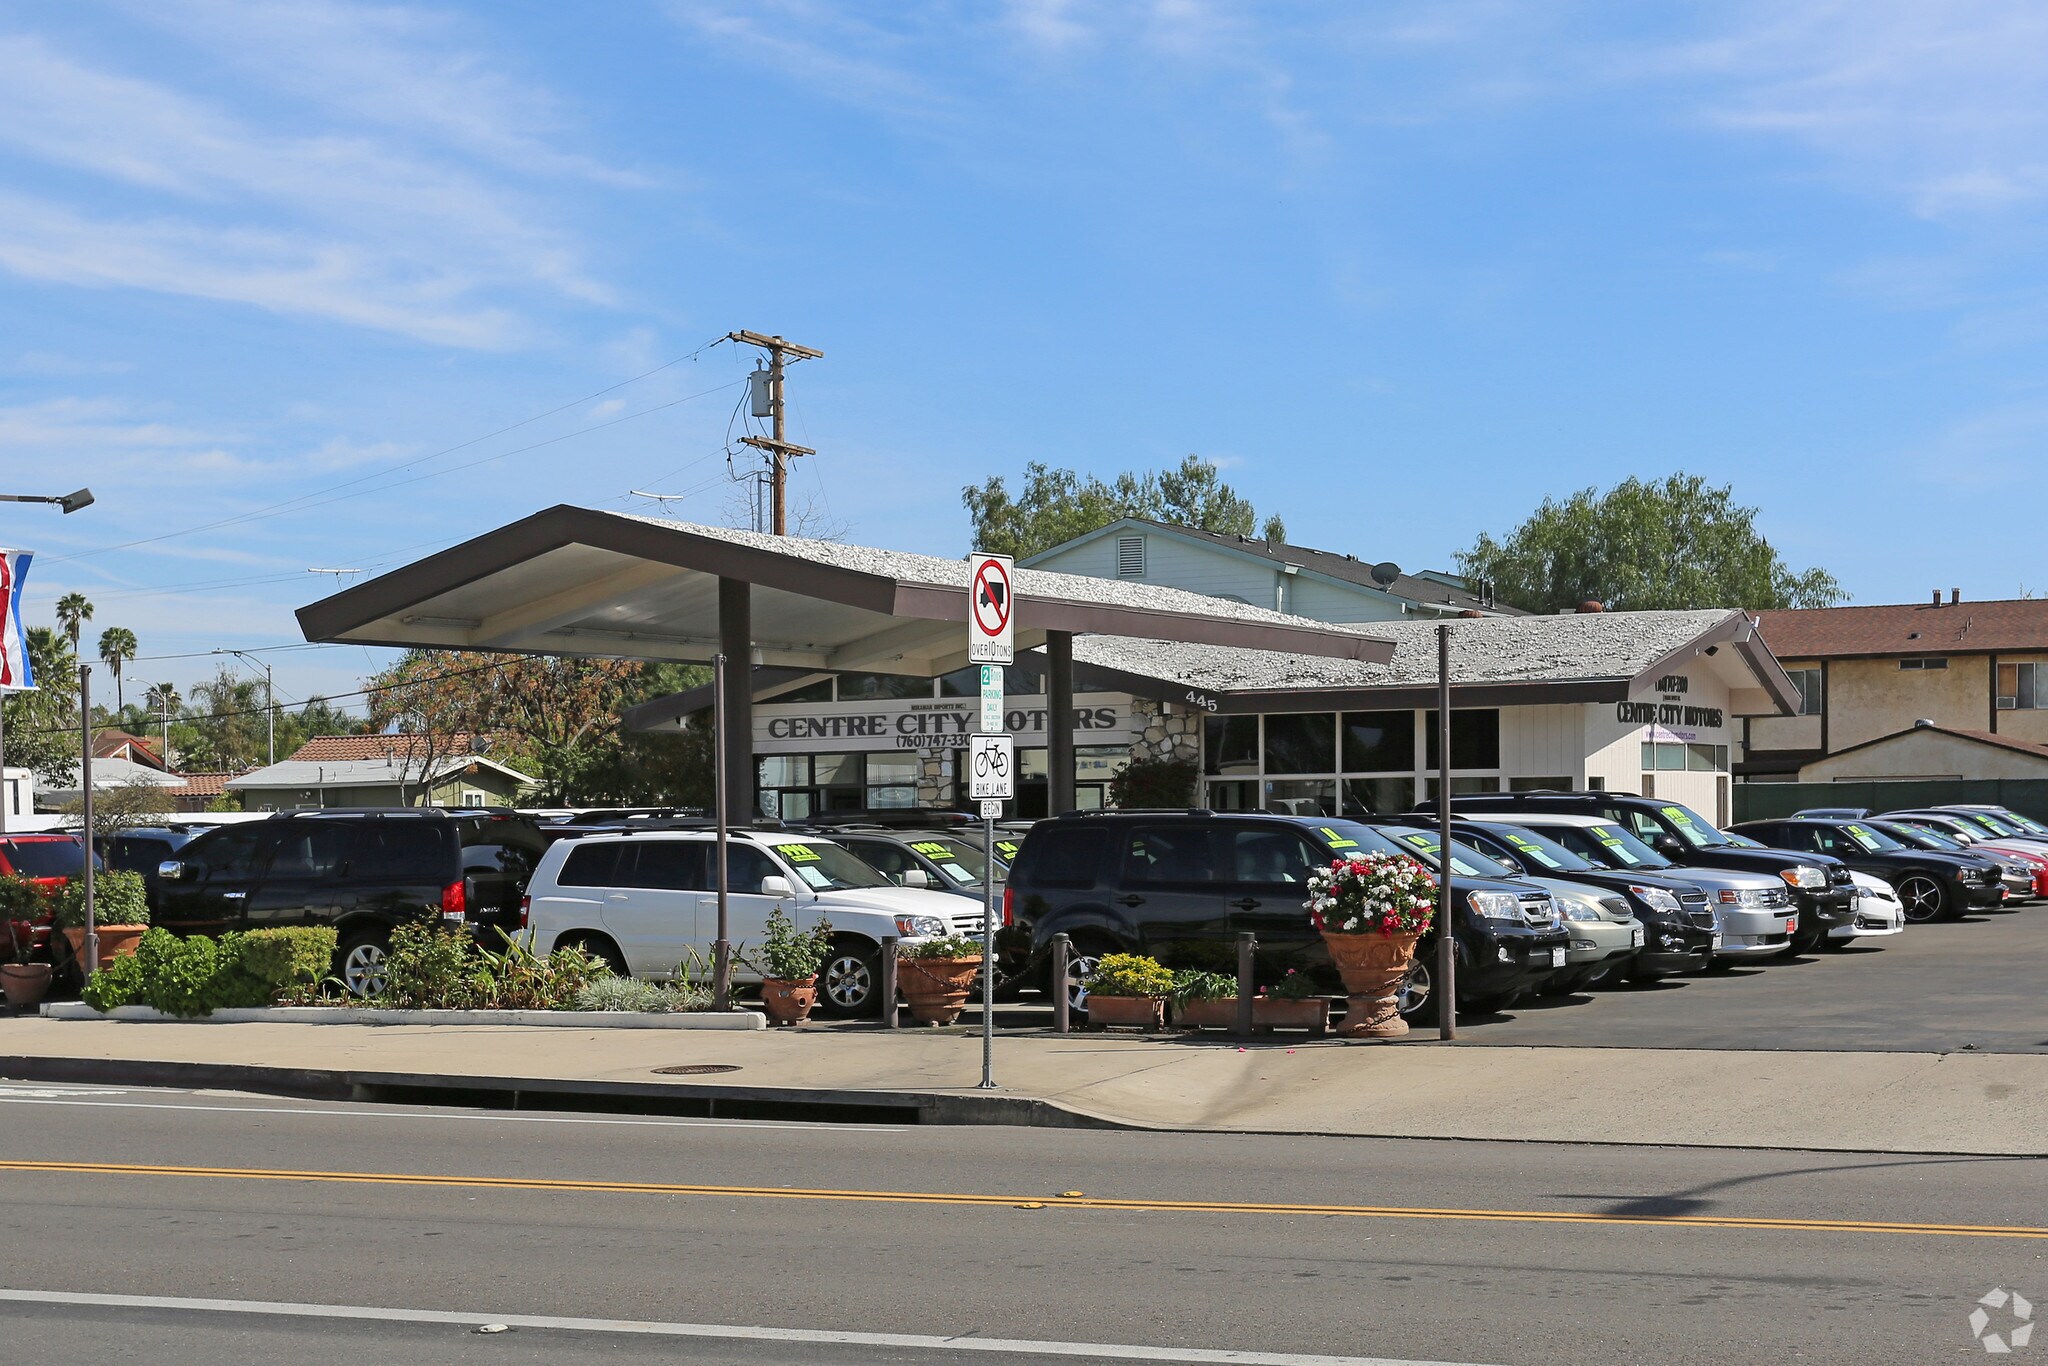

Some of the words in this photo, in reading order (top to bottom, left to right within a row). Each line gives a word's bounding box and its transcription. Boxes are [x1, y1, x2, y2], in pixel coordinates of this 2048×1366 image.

[983, 689, 1001, 700] PARKING
[1185, 690, 1218, 711] 445
[986, 703, 998, 712] DAILY
[1617, 701, 1657, 724] CENTRE
[1659, 703, 1683, 725] CITY
[1684, 706, 1723, 728] MOTORS
[768, 715, 888, 738] CENTRE
[896, 713, 974, 734] CITY
[1005, 708, 1117, 732] OTRS
[896, 734, 970, 748] (760)747-330
[976, 783, 990, 795] BIKE
[991, 783, 1007, 795] LANE
[984, 802, 1000, 815] BEGIN
